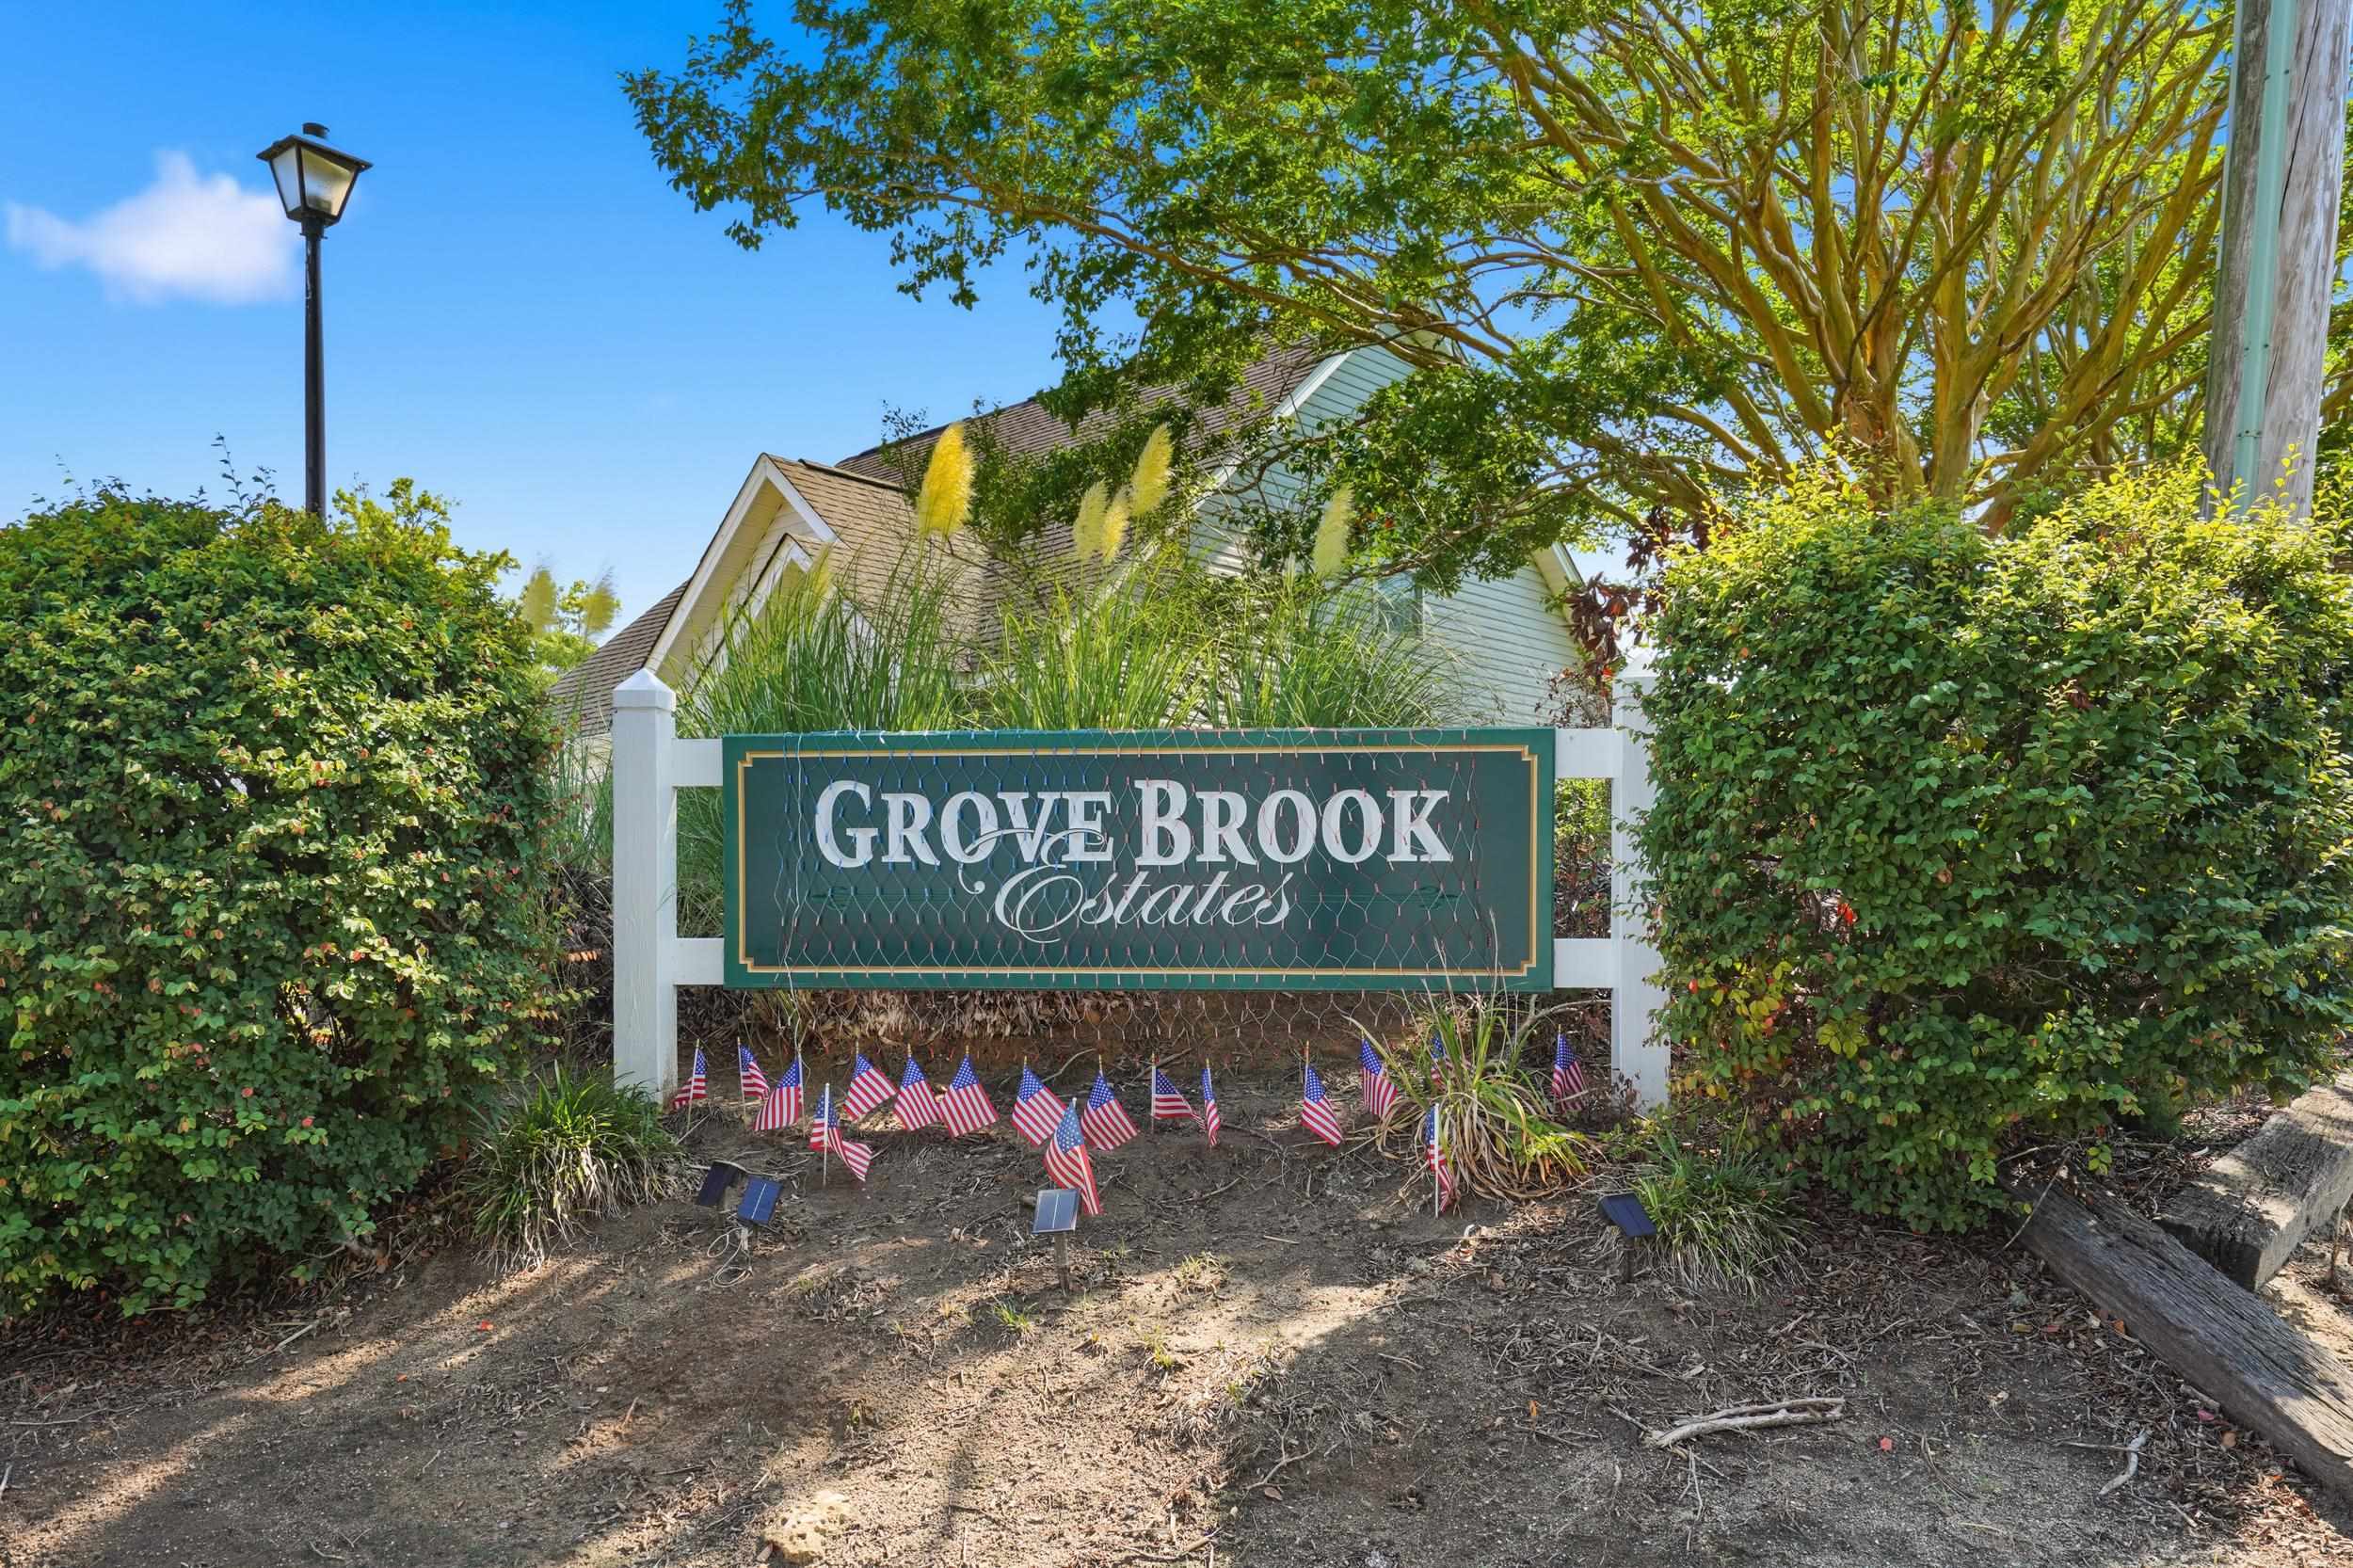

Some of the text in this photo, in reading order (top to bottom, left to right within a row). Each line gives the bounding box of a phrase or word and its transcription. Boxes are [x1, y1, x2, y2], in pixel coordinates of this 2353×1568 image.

[815, 779, 1452, 868] GROVE BROOK
[959, 828, 1292, 943] Estates
